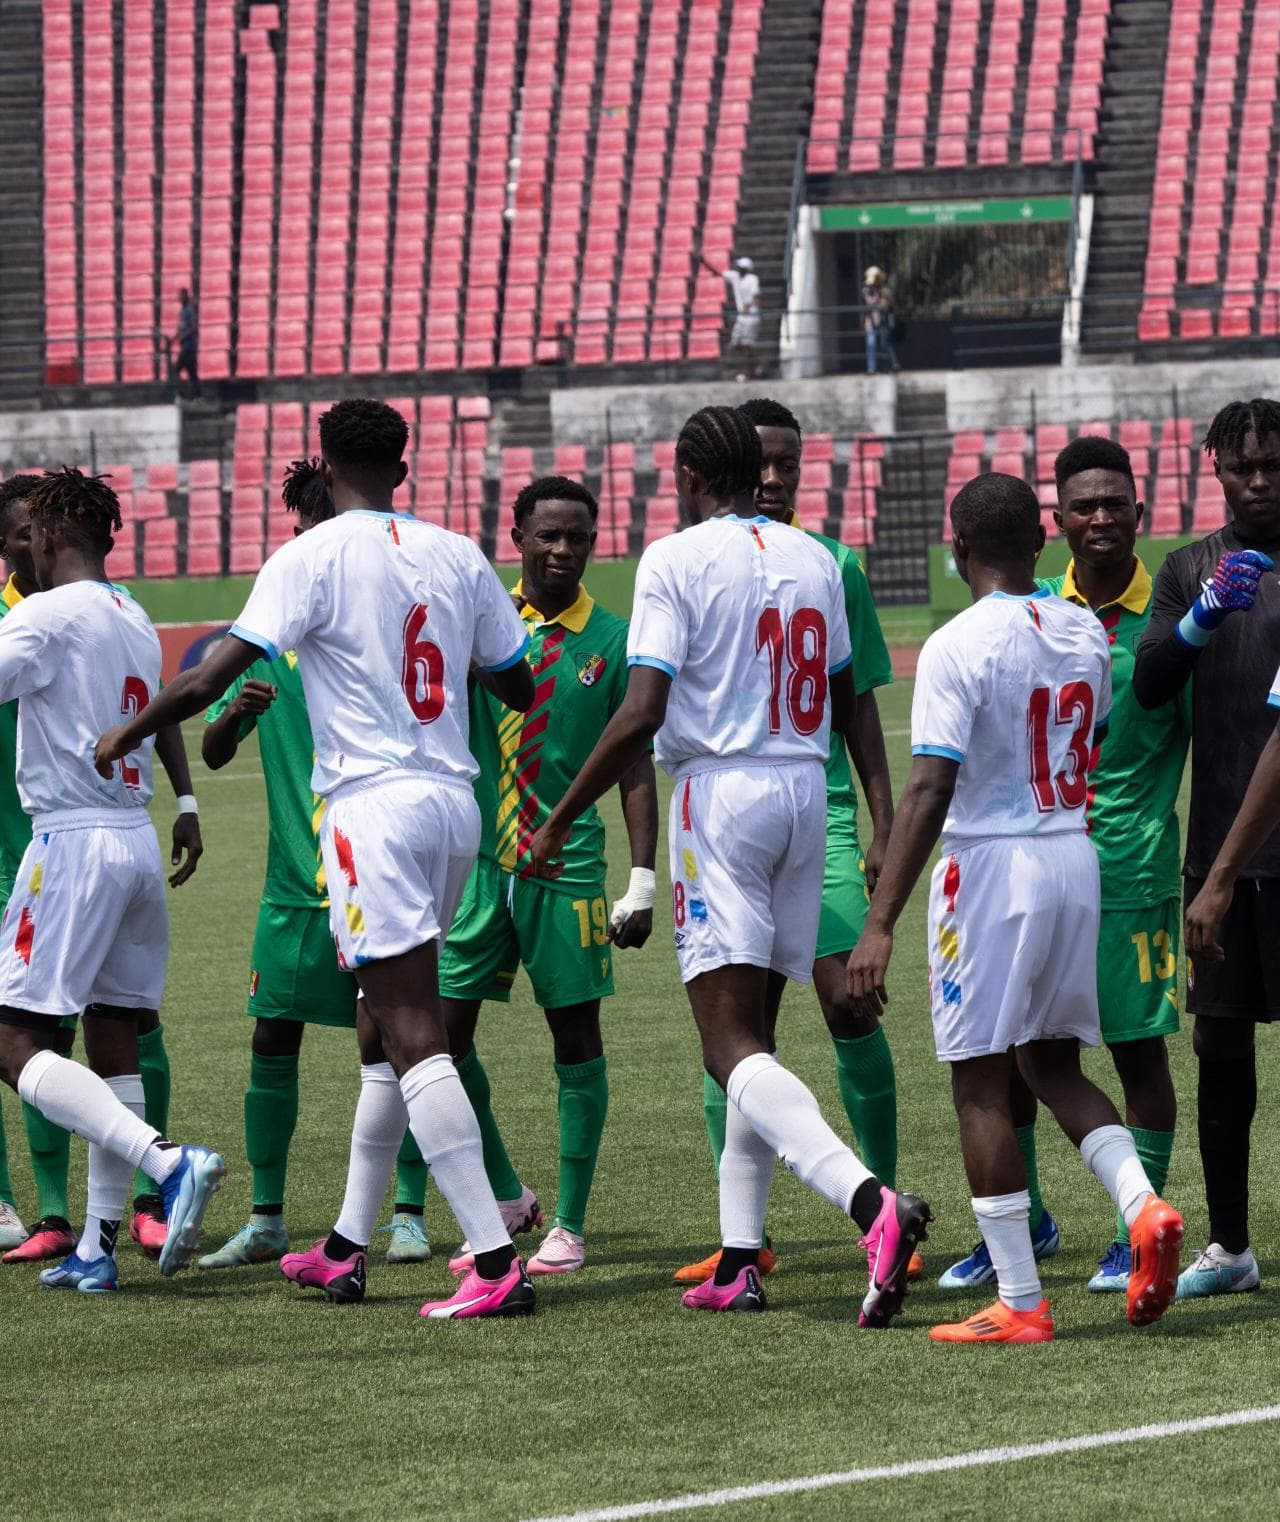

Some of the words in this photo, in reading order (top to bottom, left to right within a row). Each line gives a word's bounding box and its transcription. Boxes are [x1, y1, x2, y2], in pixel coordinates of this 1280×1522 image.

[401, 601, 446, 726] 6
[755, 607, 828, 737] 18
[1026, 680, 1095, 814] 13
[572, 896, 608, 949] 19
[672, 880, 686, 929] 8
[1131, 928, 1176, 984] 13
